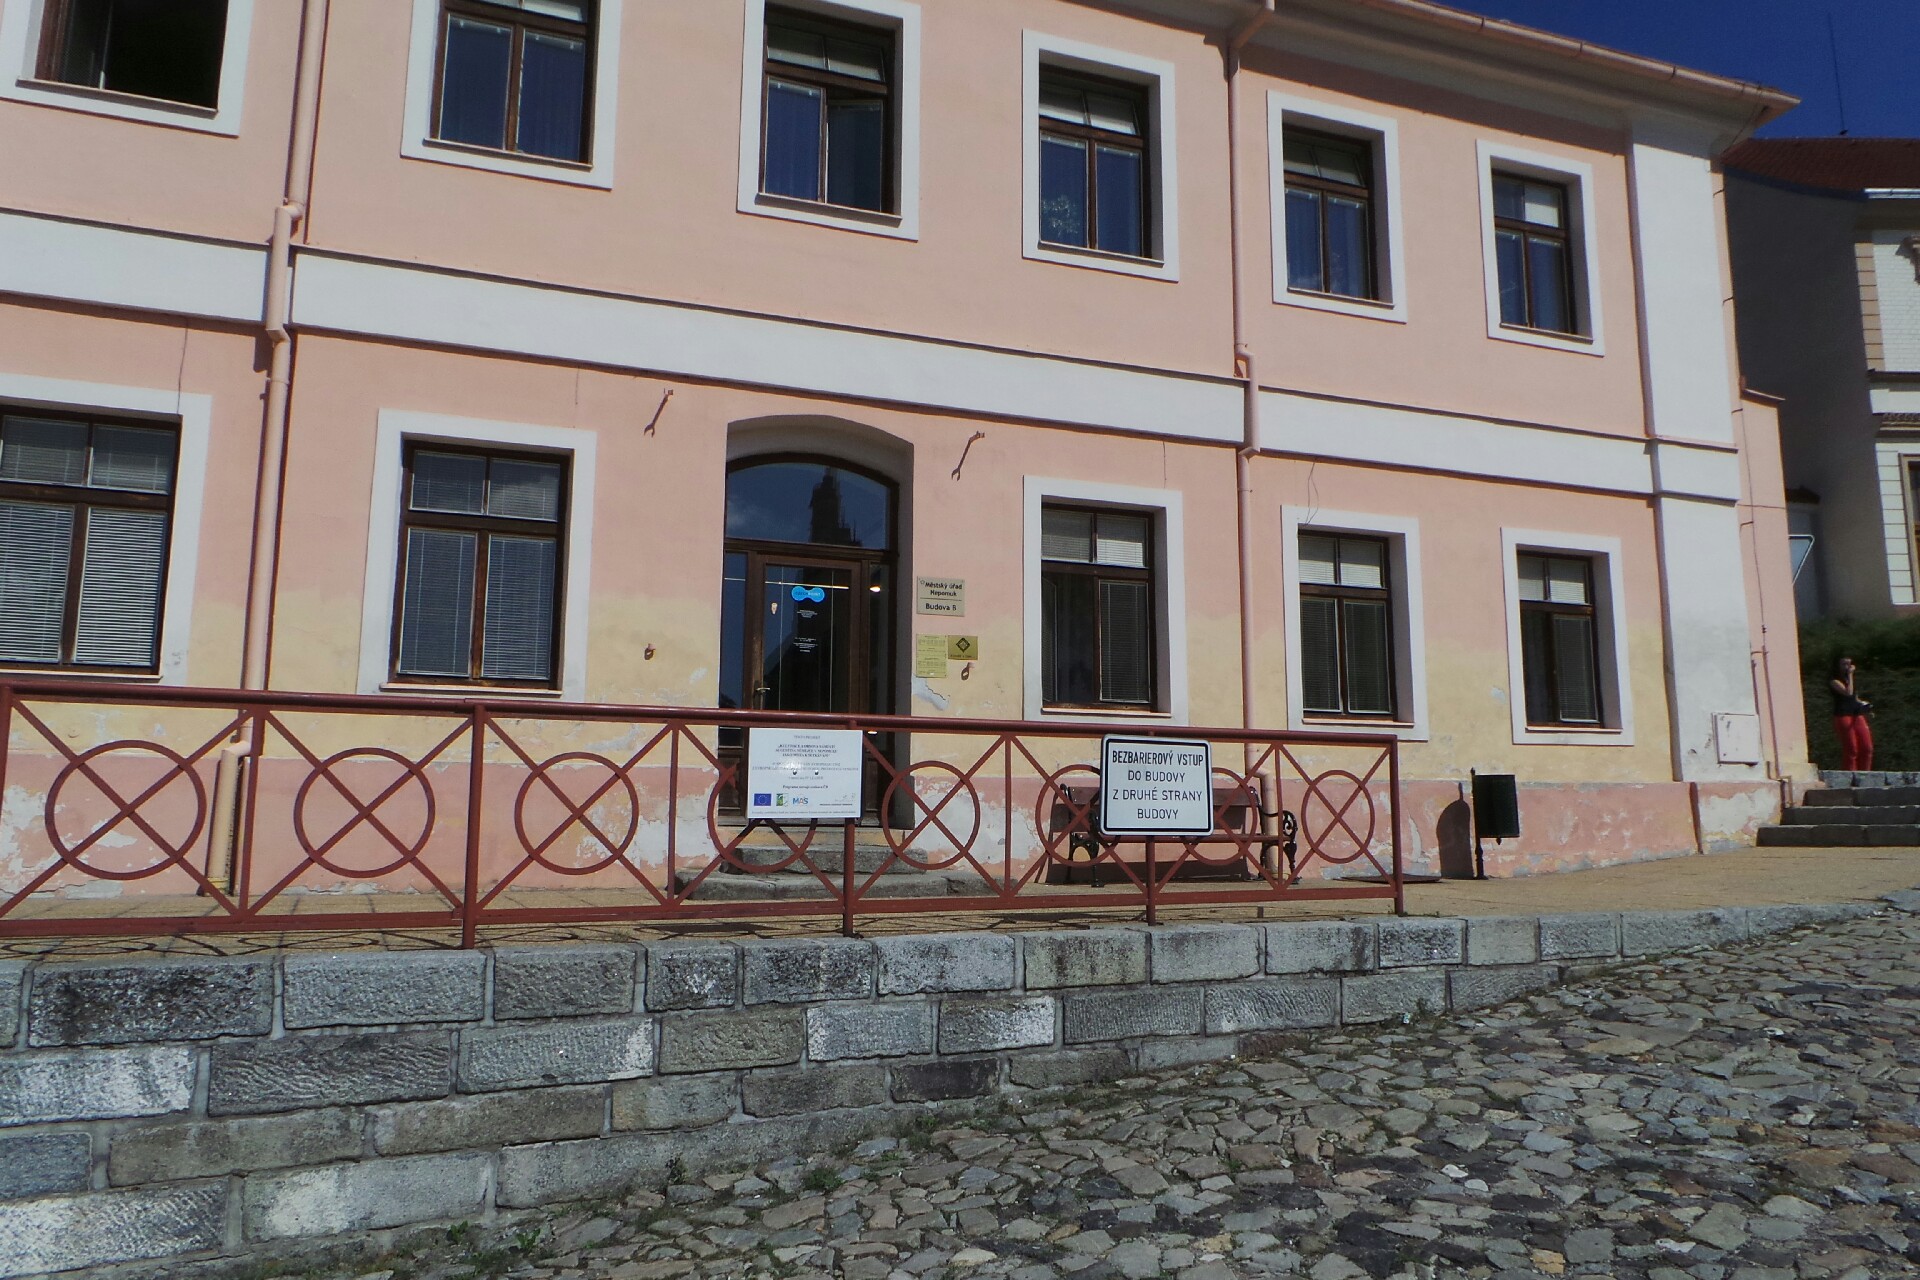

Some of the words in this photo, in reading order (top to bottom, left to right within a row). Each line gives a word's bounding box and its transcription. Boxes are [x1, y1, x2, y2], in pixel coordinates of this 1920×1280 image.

[924, 581, 948, 590] Městský
[925, 603, 950, 611] Budova
[1112, 750, 1174, 766] BEZBARIEROVÝ
[1177, 753, 1204, 767] VSTUP
[1128, 770, 1142, 781] DO
[1145, 771, 1186, 783] BUDOVY
[1112, 788, 1119, 800] Z
[1122, 786, 1158, 801] DRUHÉ
[1161, 790, 1202, 802] STRANY
[1137, 808, 1179, 820] BUDOVY
